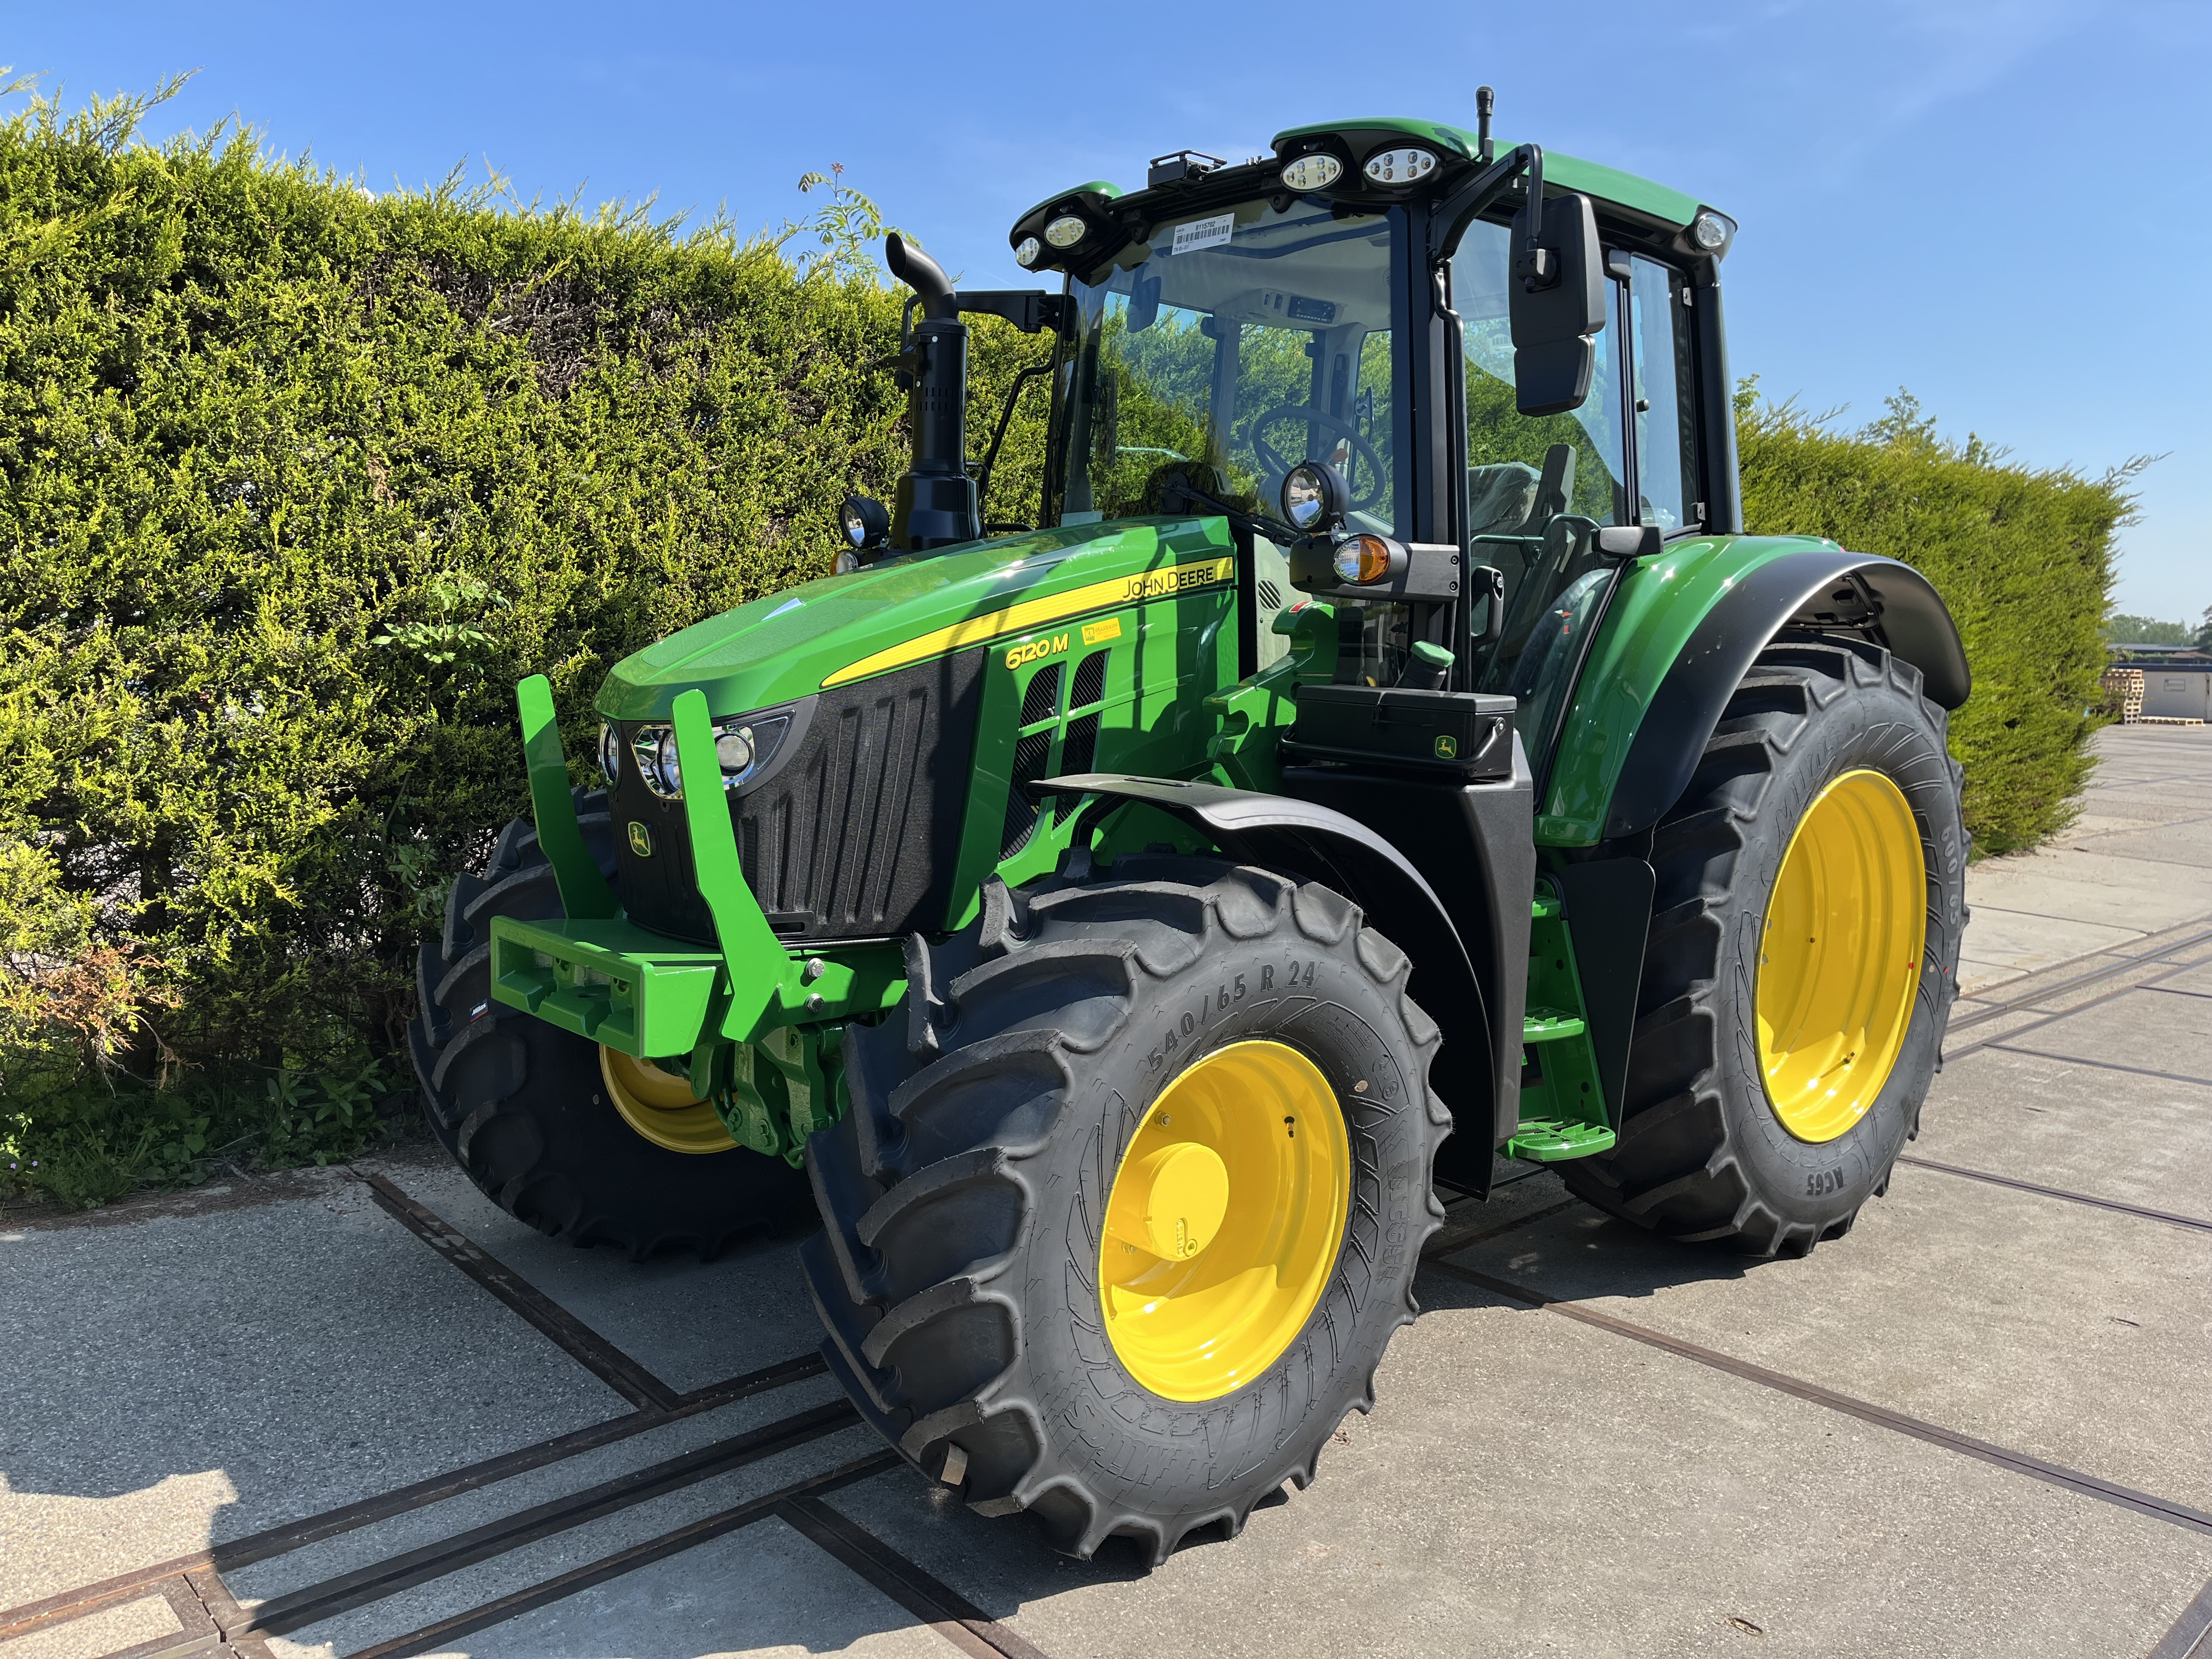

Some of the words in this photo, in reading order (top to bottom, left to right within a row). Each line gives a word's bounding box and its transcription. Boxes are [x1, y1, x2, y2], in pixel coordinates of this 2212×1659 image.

[1195, 221, 1216, 231] 8115702
[1122, 575, 1164, 599] JOHN
[1167, 566, 1214, 589] DEERE
[1147, 973, 1246, 1075] 540/65
[1261, 963, 1275, 993] R
[1286, 960, 1316, 988] 24
[1807, 1165, 1844, 1196] AC65
